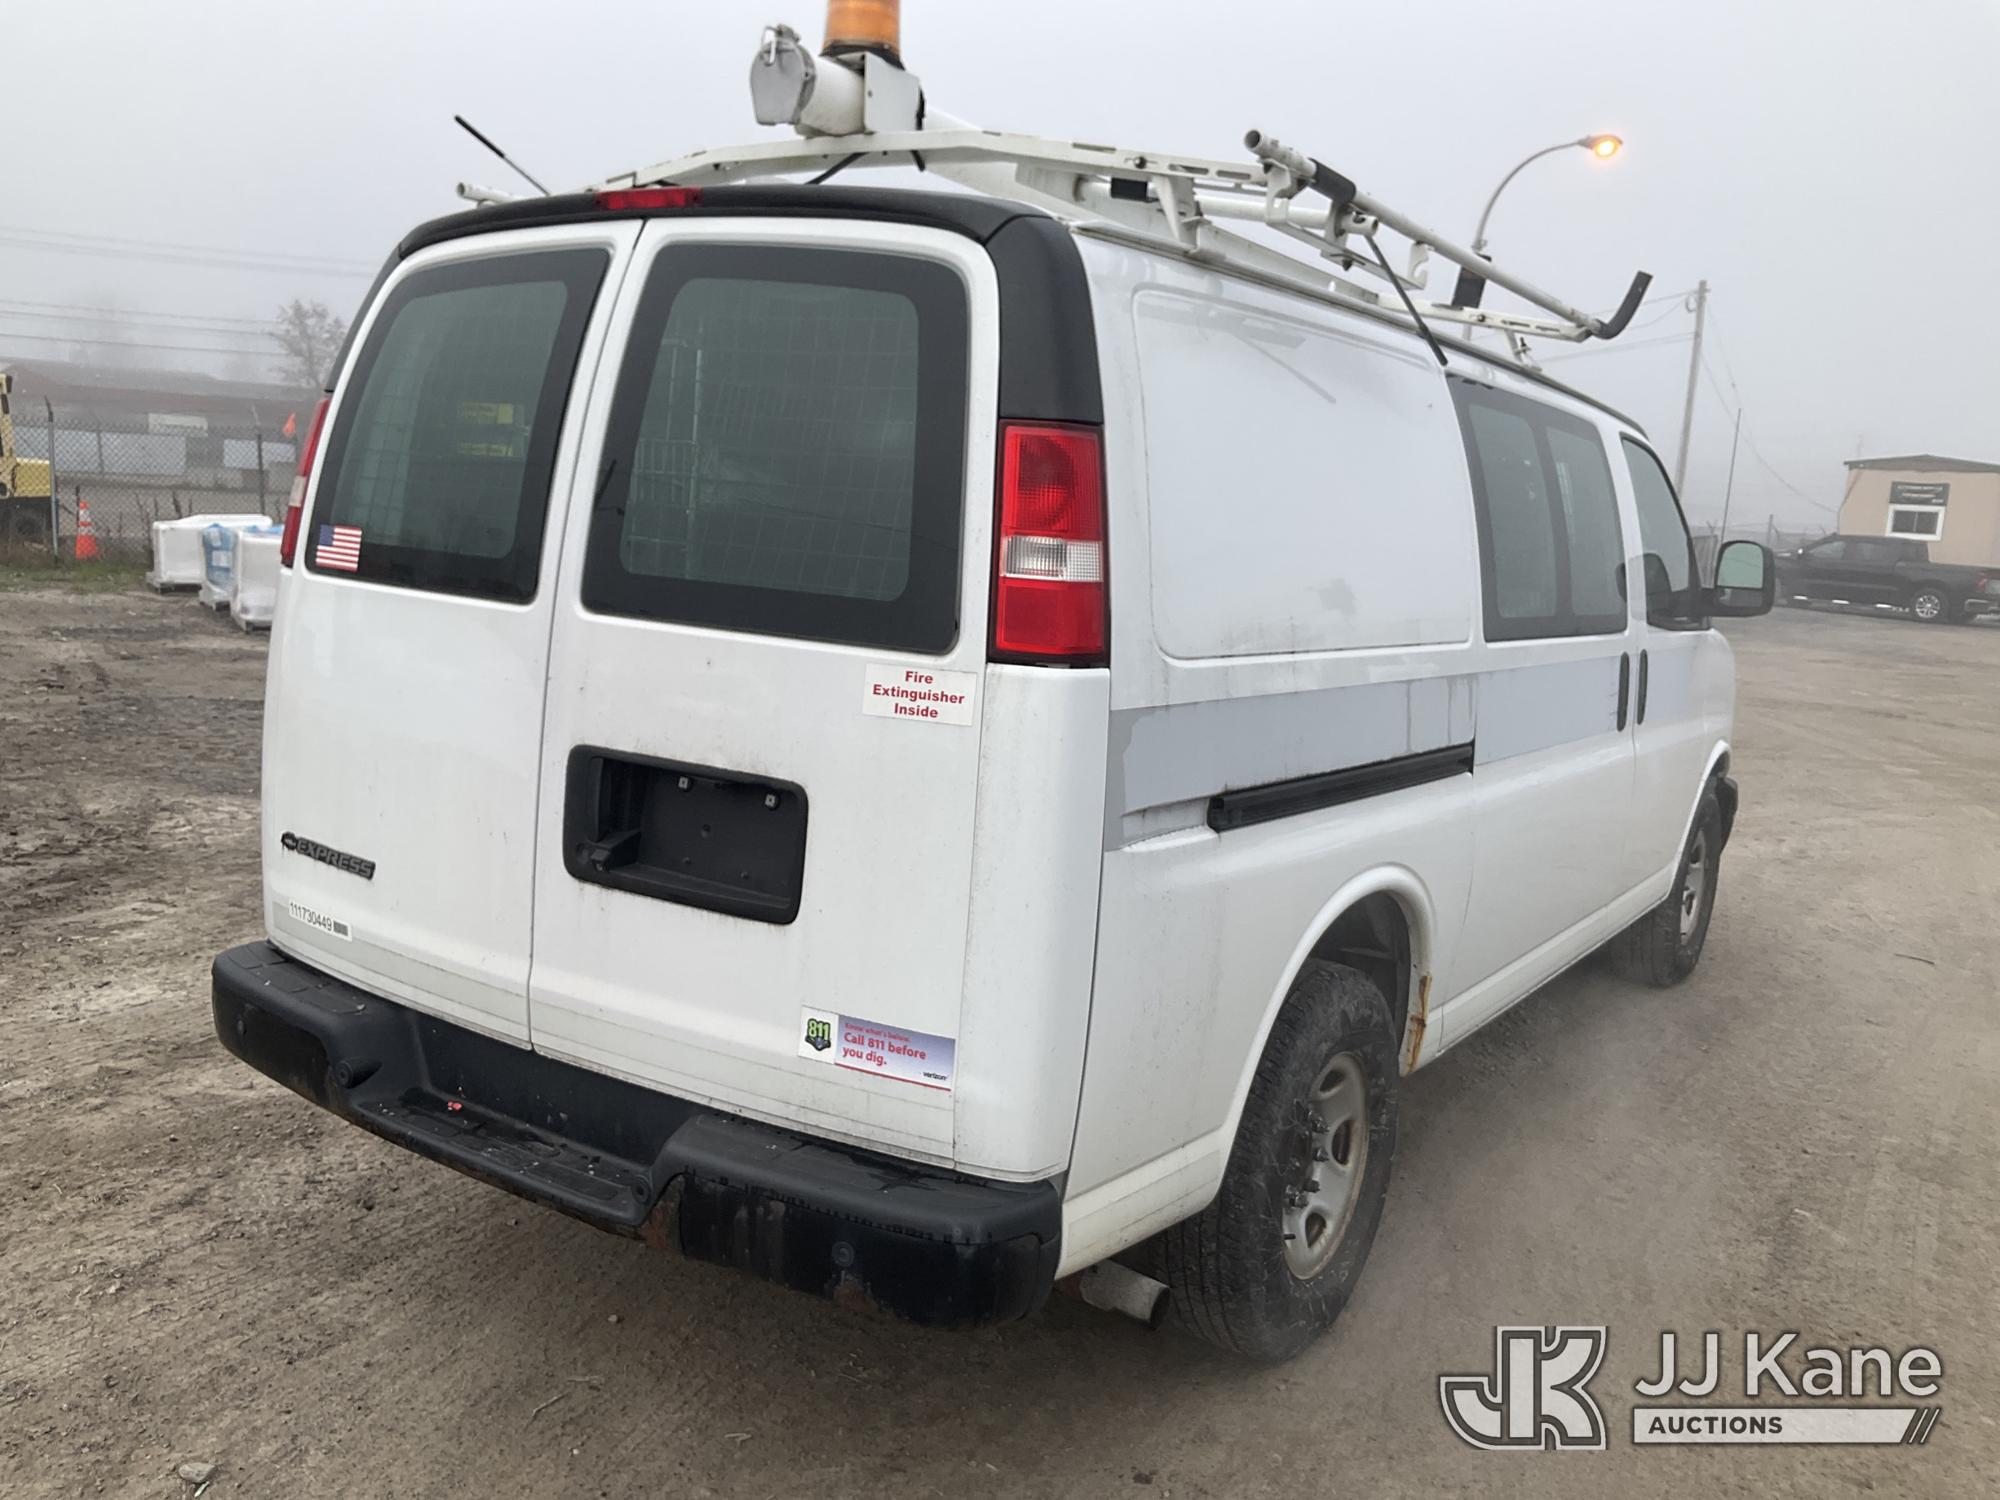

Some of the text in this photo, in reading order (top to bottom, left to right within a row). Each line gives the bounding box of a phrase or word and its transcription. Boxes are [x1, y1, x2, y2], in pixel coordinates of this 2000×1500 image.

[905, 671, 934, 684] Fire
[872, 684, 965, 704] Extinguisher
[894, 703, 939, 718] Inside
[296, 838, 375, 879] EXPRESS
[290, 902, 333, 931] 111730449
[808, 1018, 831, 1040] 811
[844, 1032, 927, 1060] Call 811 before
[842, 1047, 887, 1067] you dig.
